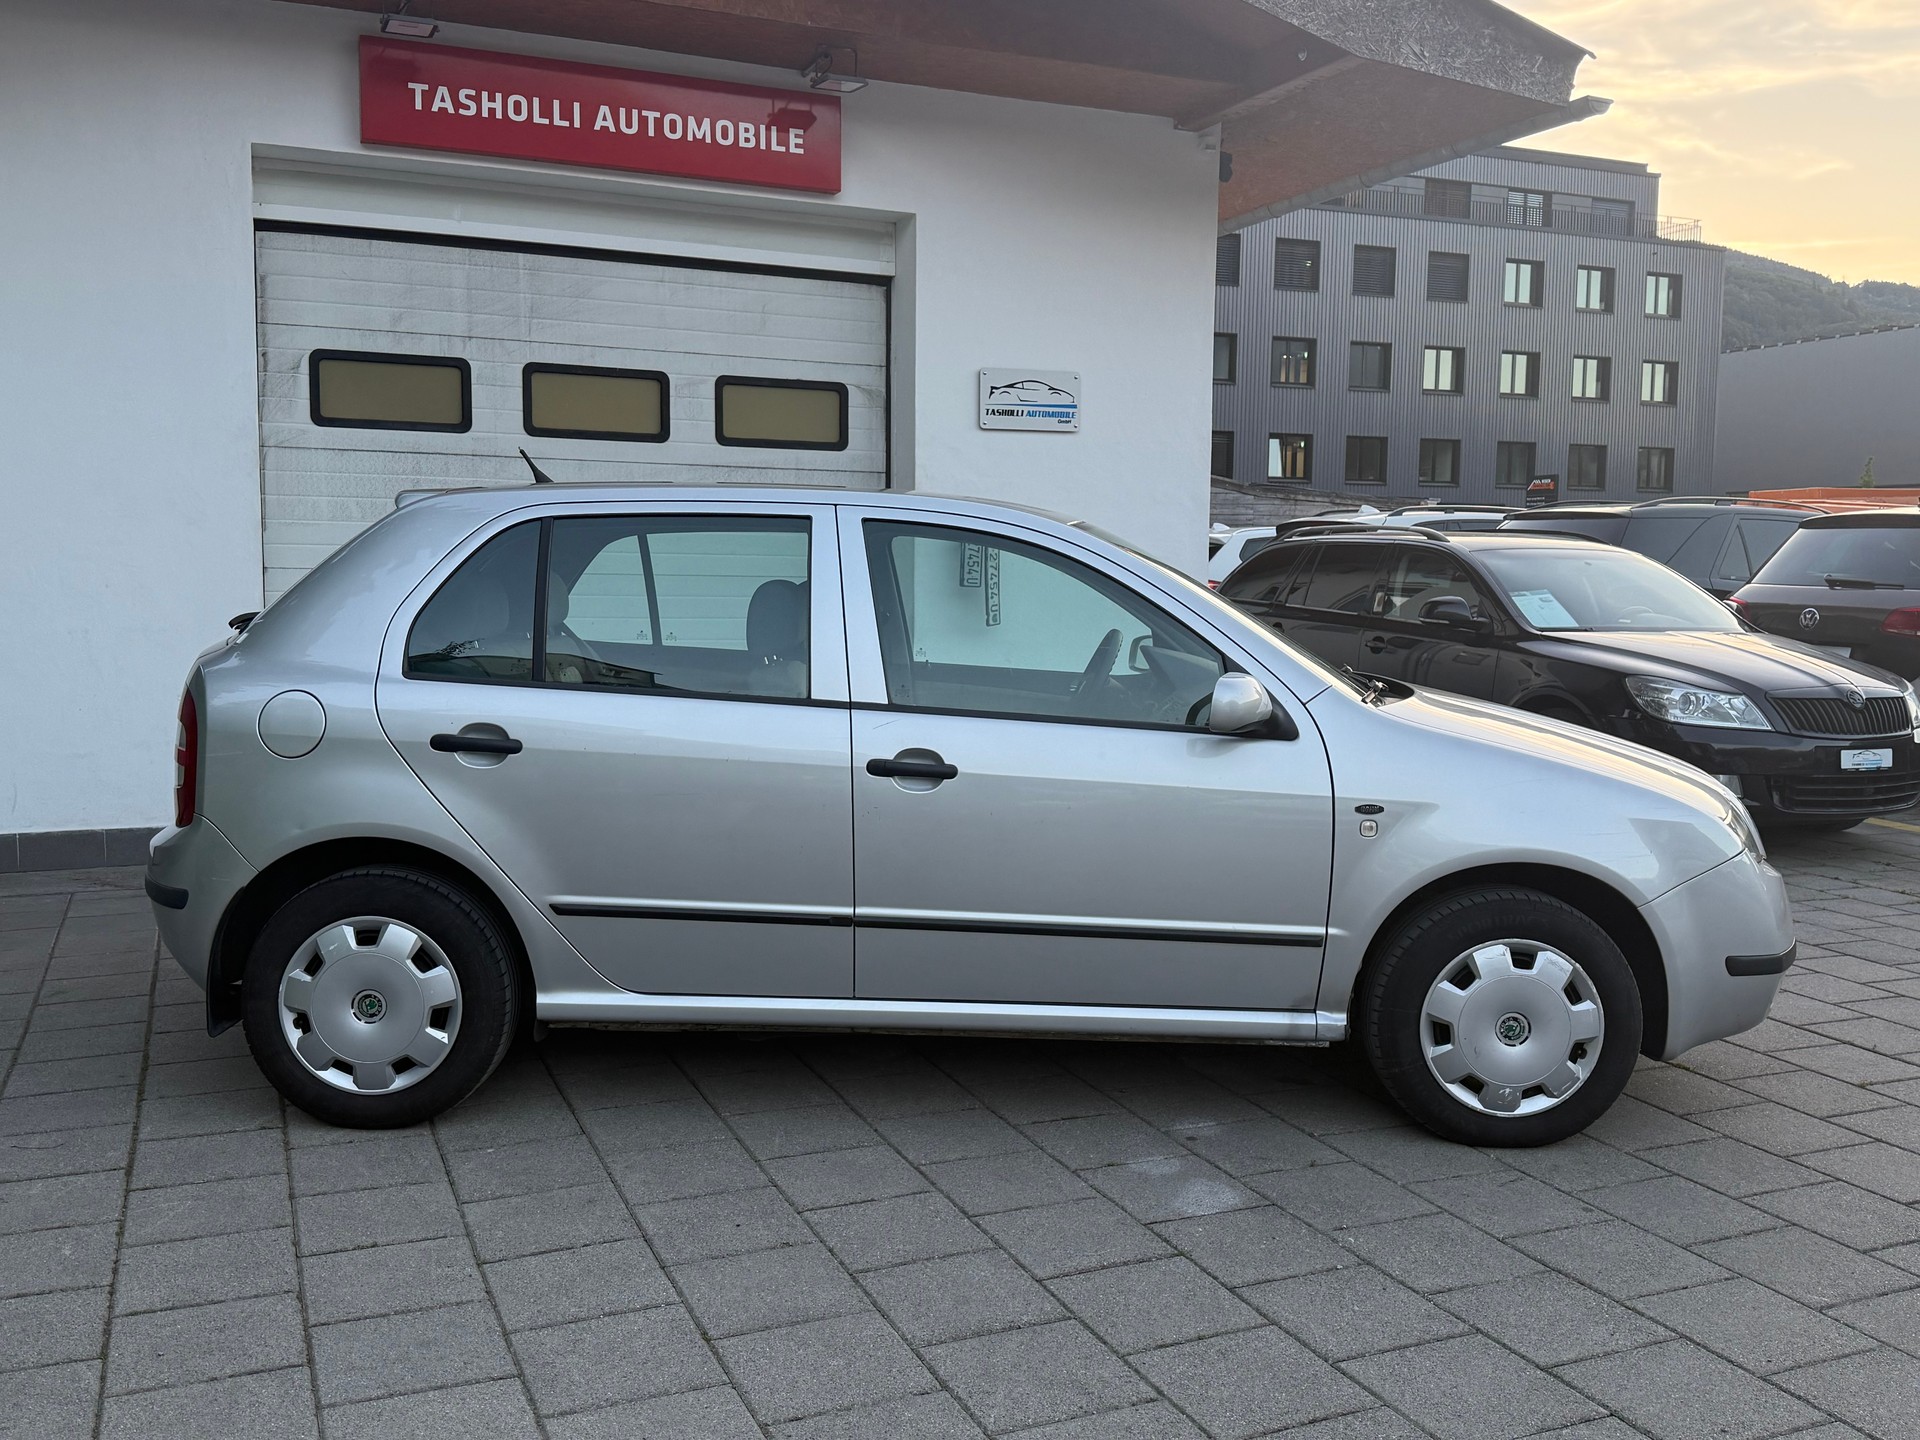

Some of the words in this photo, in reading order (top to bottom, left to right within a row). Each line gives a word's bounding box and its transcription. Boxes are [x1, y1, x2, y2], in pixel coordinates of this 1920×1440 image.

[408, 82, 581, 129] TASHOLLI
[593, 105, 805, 155] AUTOMOBILE
[985, 408, 1024, 417] TASHOLLI
[1025, 410, 1076, 419] AUTOMOBILE
